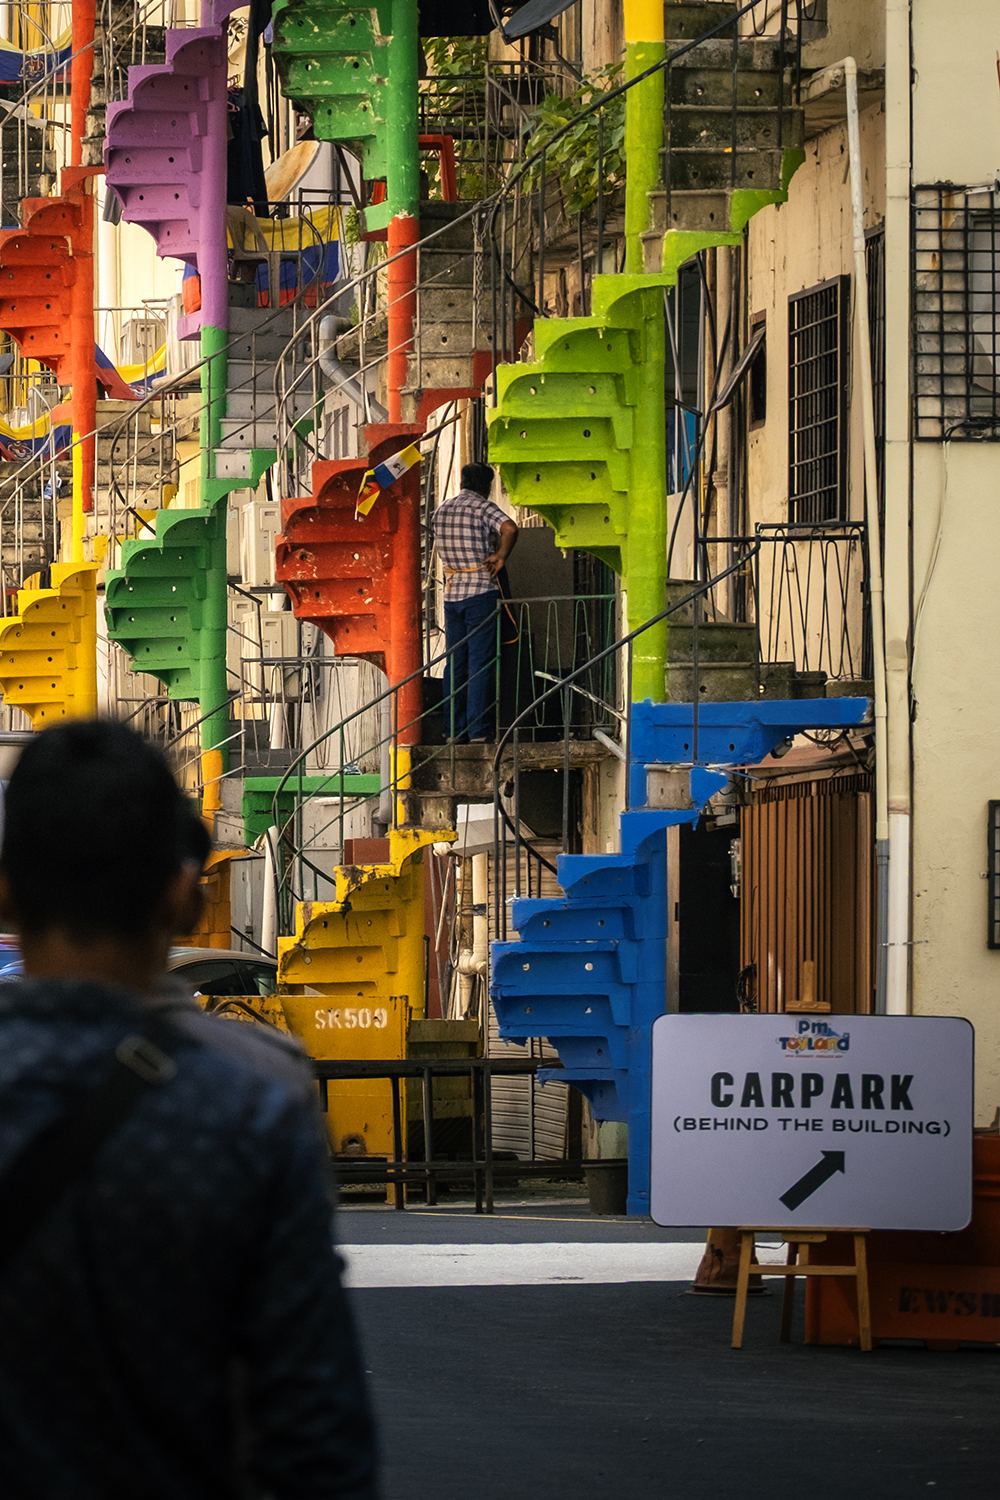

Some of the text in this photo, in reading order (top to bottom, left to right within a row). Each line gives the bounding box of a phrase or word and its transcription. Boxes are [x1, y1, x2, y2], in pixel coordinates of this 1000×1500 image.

[711, 1072, 914, 1110] CARPARK
[673, 1116, 951, 1137] (BEHIND THE BUILDING)
